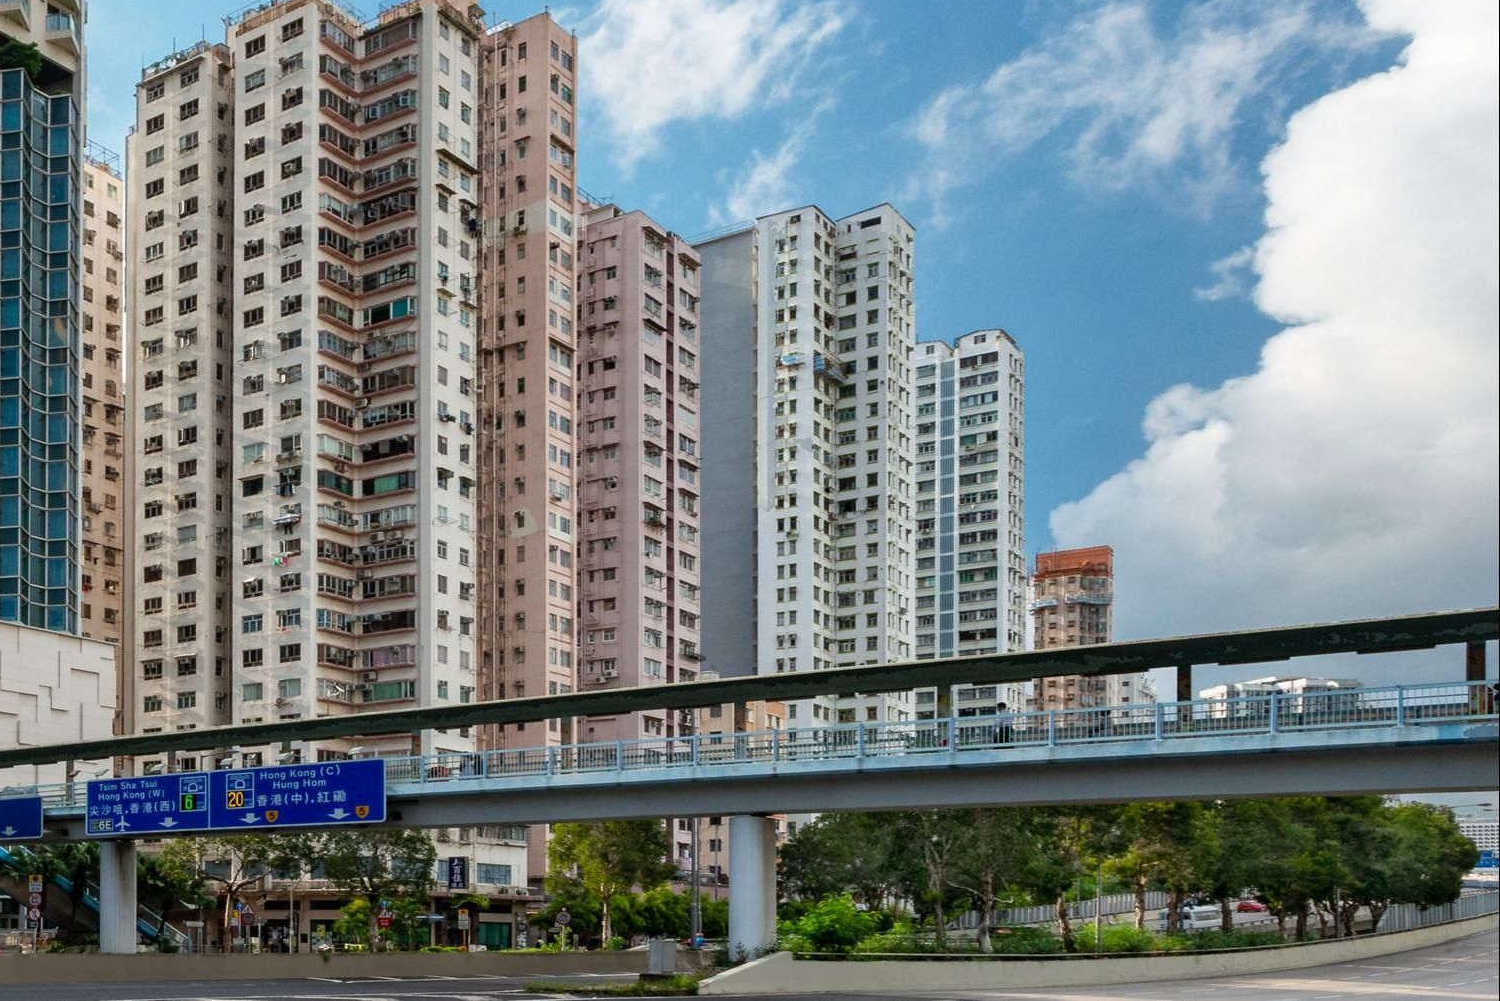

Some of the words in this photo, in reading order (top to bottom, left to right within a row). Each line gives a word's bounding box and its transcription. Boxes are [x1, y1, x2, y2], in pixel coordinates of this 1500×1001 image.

[260, 771, 286, 780] Hong
[290, 769, 316, 779] Kong
[320, 765, 341, 776] (C)
[140, 780, 158, 788] Tsui
[273, 780, 299, 789] Hung
[303, 778, 327, 787] Hom
[98, 793, 120, 801] Hong
[123, 791, 146, 799] Kong
[148, 789, 165, 798] (W)
[228, 791, 244, 807] 20
[185, 794, 193, 809] 6
[98, 820, 112, 830] 6E
